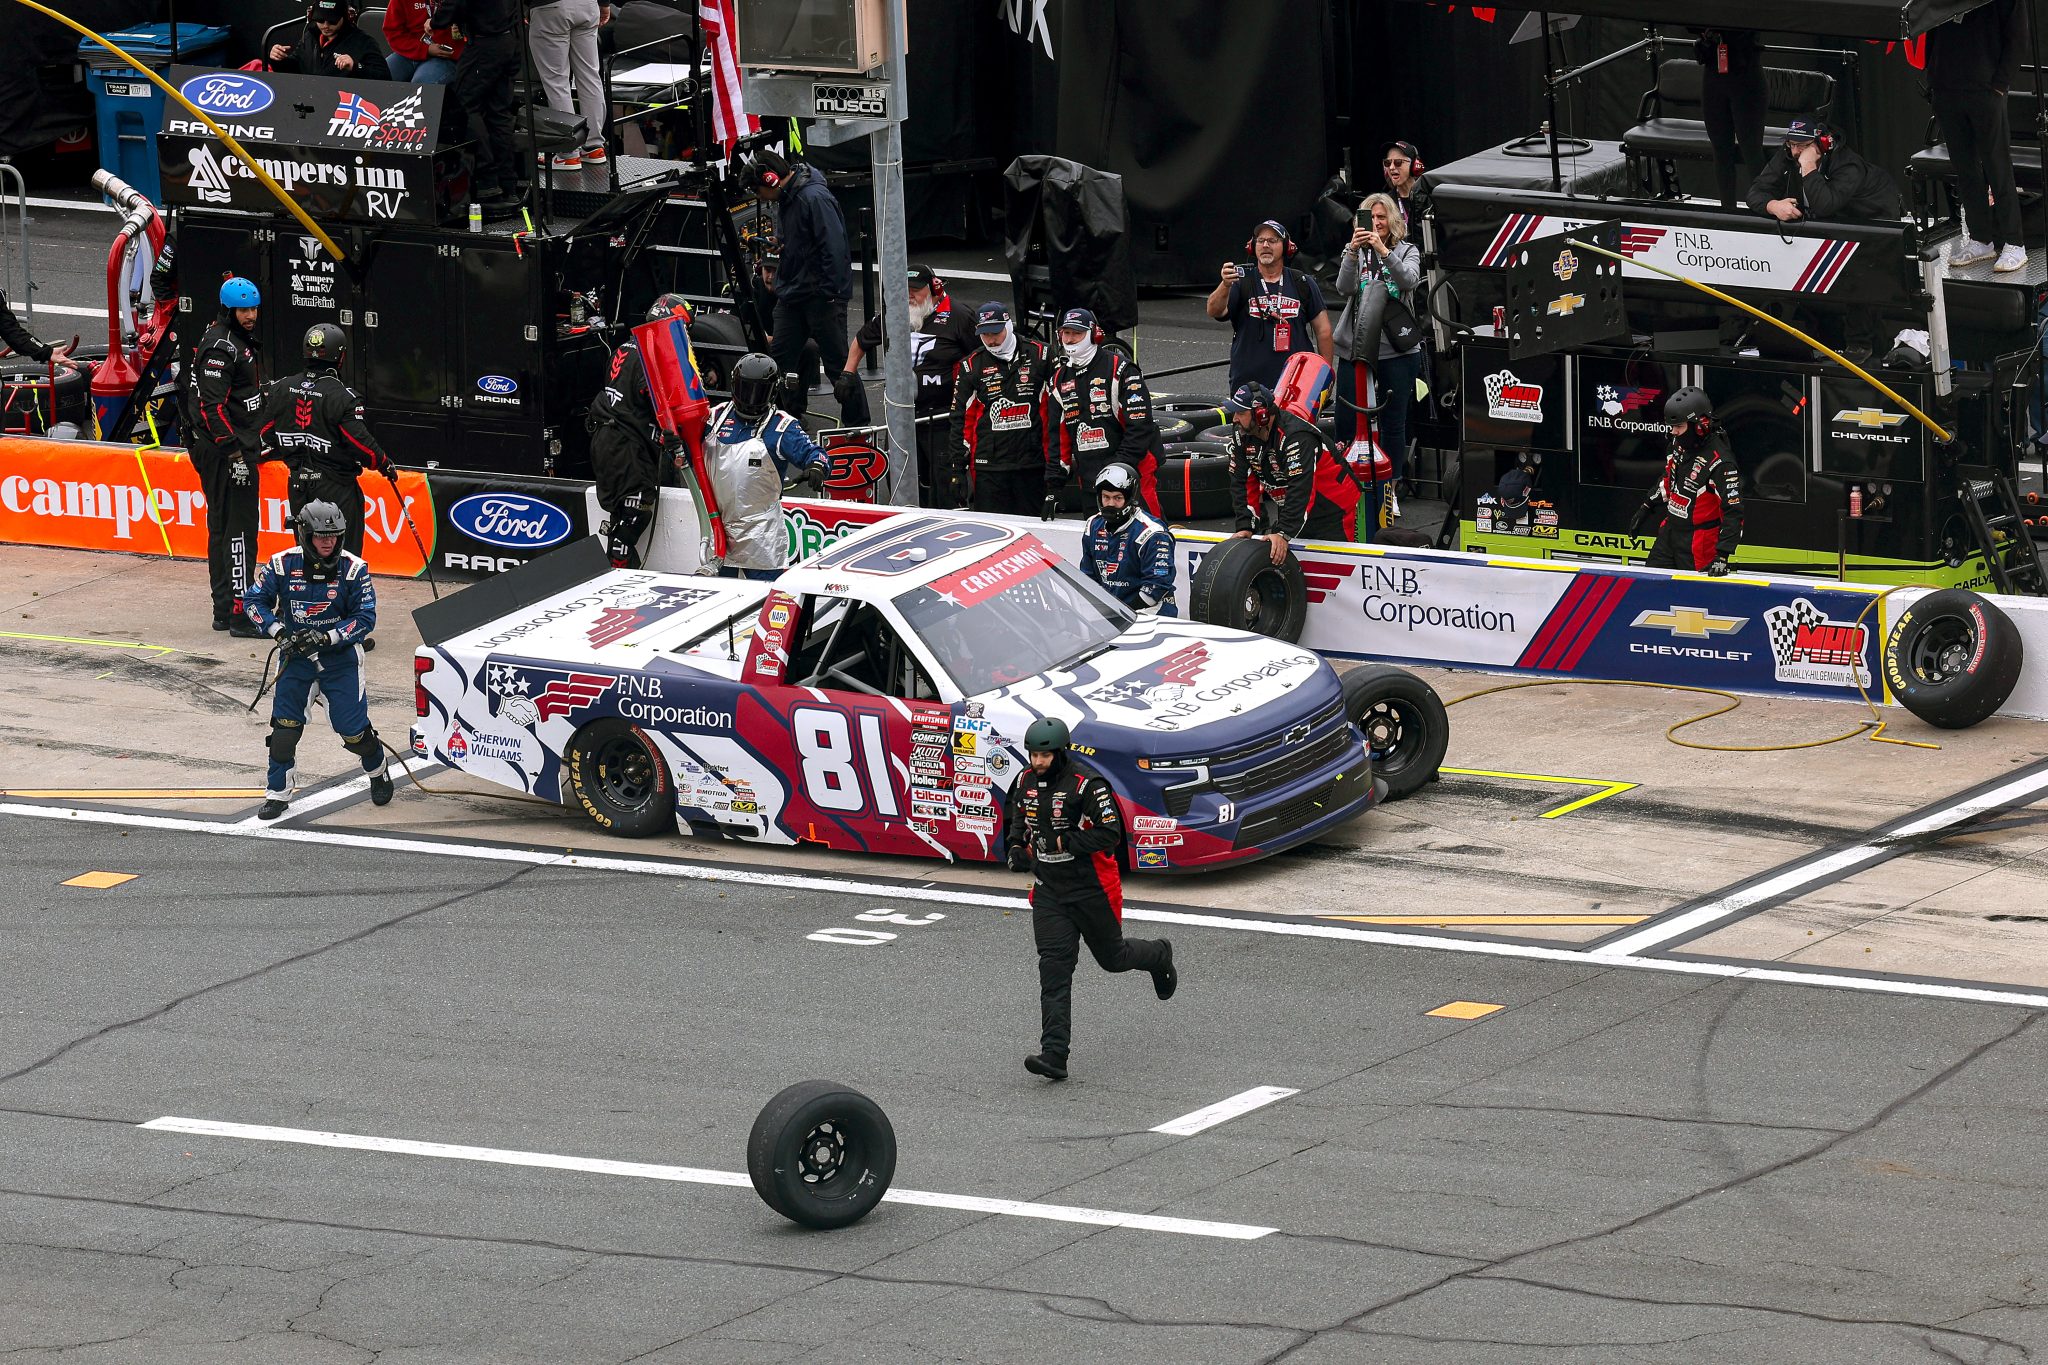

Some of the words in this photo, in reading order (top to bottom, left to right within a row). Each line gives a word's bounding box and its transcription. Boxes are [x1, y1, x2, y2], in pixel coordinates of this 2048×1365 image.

[198, 79, 256, 107] Ford
[869, 89, 880, 97] 15
[365, 139, 424, 150] RACING
[355, 156, 407, 190] inn
[366, 190, 403, 219] RV
[1674, 232, 1714, 251] F.N.B.
[289, 258, 334, 273] TYM
[1676, 251, 1771, 274] Corporation
[301, 275, 334, 285] campers
[292, 294, 335, 308] FarmPaint
[485, 378, 510, 392] Ford
[474, 395, 521, 405] RACING
[1588, 416, 1612, 429] F.N.B.
[1614, 417, 1673, 434] Corporation
[1831, 431, 1911, 444] CHEVROLET
[1, 473, 206, 540] camper
[468, 499, 548, 540] Ford
[1574, 533, 1651, 551] CARLYL
[444, 552, 528, 573] RAC
[960, 546, 1043, 593] CRAFTSMAN
[1361, 564, 1422, 595] F.N.B.
[1954, 573, 1995, 590] CARLYL
[771, 611, 786, 622] NAPA
[1362, 596, 1516, 633] Corporation
[475, 596, 603, 650] Corporation
[1630, 643, 1753, 662] CHEVROLET
[1887, 611, 1913, 690] GOODYEAR
[617, 675, 664, 698] F.N.B.
[618, 697, 732, 729] Corporation
[913, 714, 949, 725] CRAFTSMAN
[956, 718, 991, 731] SKF
[472, 730, 522, 748] SHERWIN
[912, 733, 948, 743] COMETIC
[471, 744, 523, 762] WILLIAMS
[916, 746, 941, 757] KLOTZ
[794, 708, 899, 816] 81
[911, 760, 939, 769] LINCOLN
[912, 774, 938, 788] Holley
[955, 773, 992, 785] CALICO
[913, 790, 952, 803] tilton
[957, 804, 997, 818] JESEL
[1218, 803, 1234, 824] 81
[913, 818, 938, 834] Stilo
[966, 821, 992, 832] brembo
[1138, 818, 1173, 829] SIMPSON
[1137, 834, 1182, 845] ARP
[1139, 853, 1165, 862] SUNOCO
